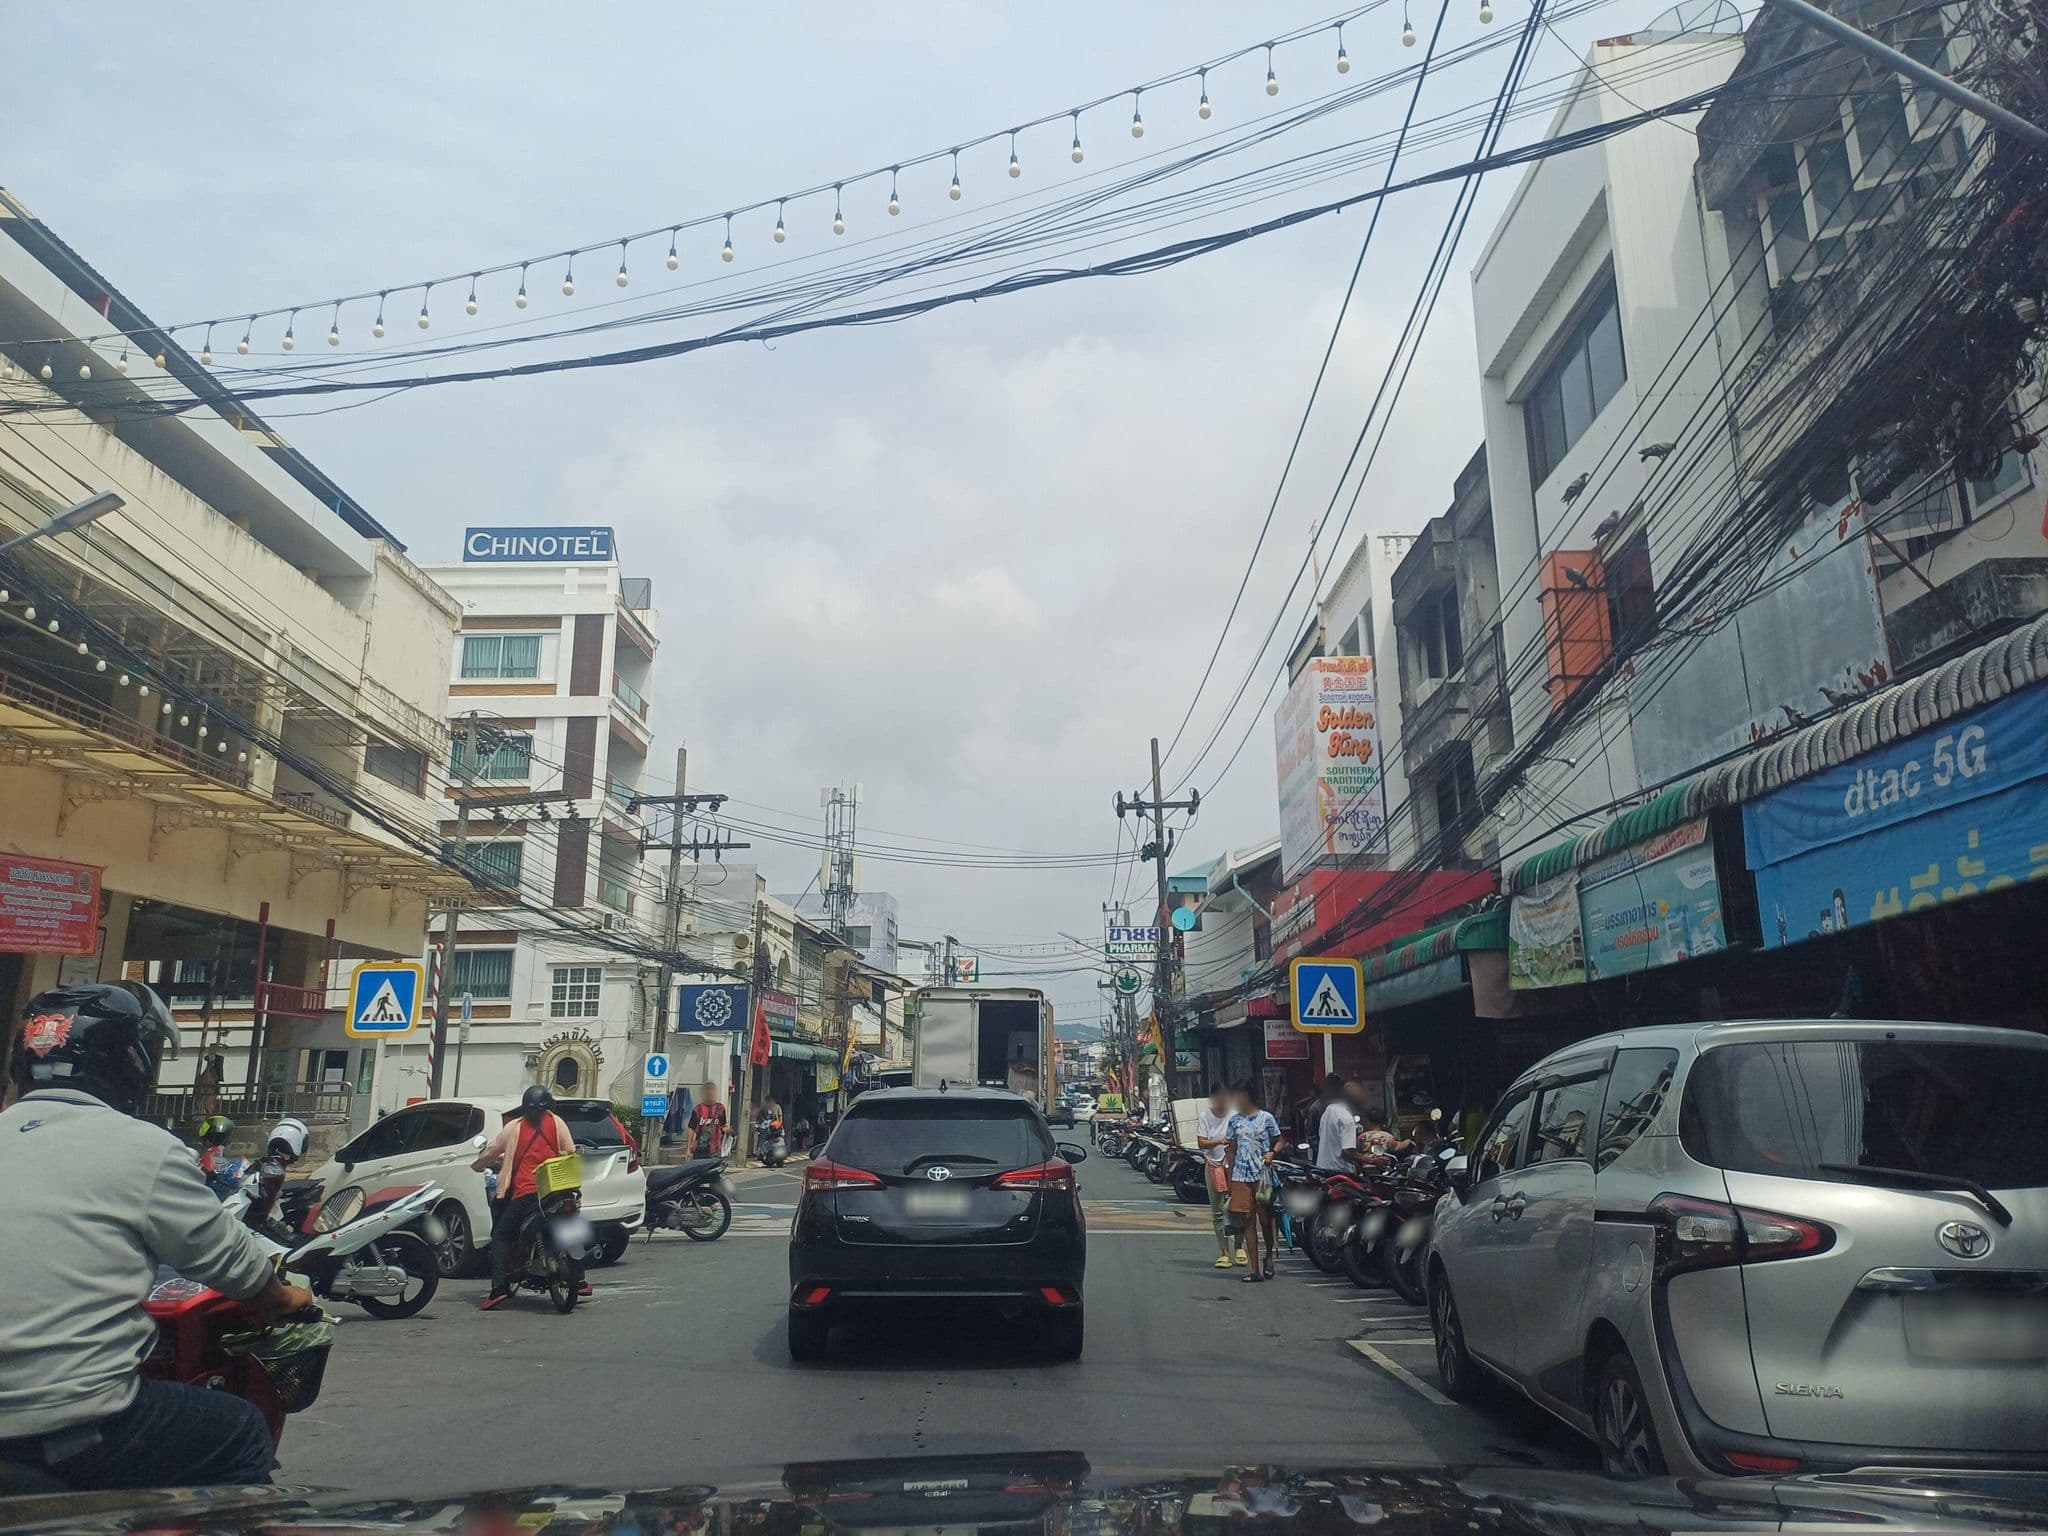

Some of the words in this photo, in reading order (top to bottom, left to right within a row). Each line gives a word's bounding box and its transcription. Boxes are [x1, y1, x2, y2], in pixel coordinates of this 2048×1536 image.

[467, 532, 607, 556] CHINOTEL
[1317, 705, 1375, 733] Golden
[1328, 731, 1373, 765] King
[1326, 766, 1374, 775] SOUTHERN
[1844, 761, 1920, 818] dtac
[1932, 725, 1986, 786] 5G
[1338, 786, 1368, 794] FOODS
[1775, 1382, 1844, 1399] SIENTA
